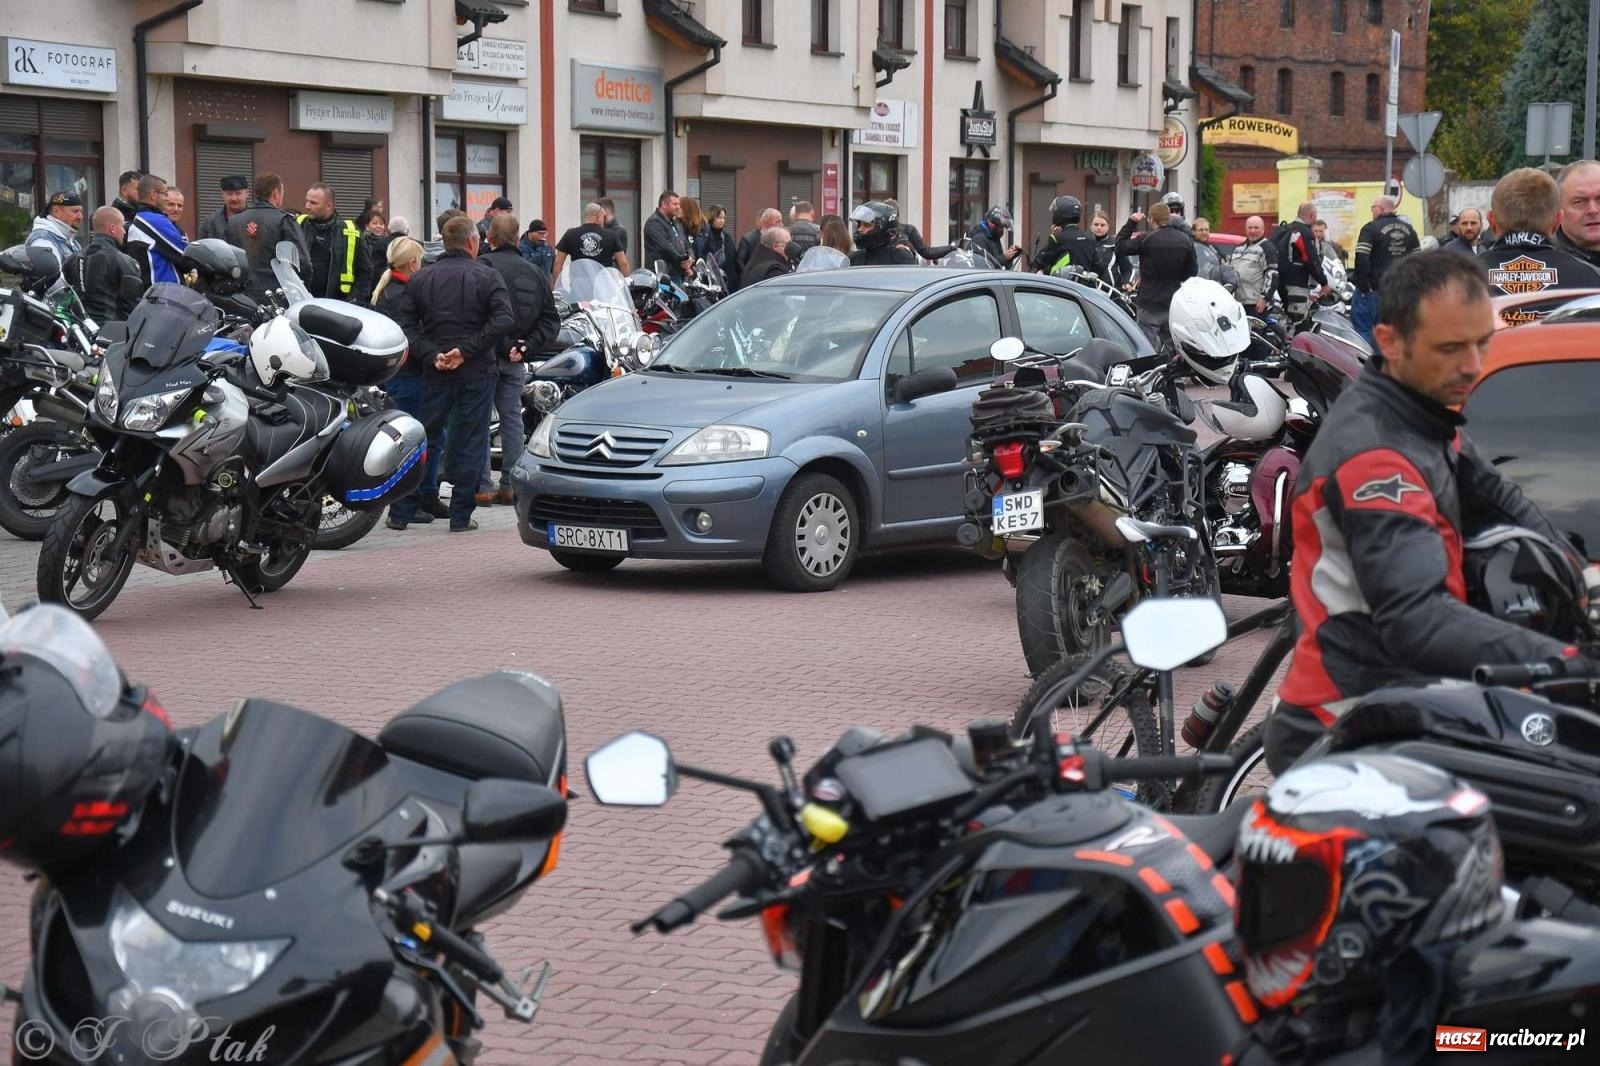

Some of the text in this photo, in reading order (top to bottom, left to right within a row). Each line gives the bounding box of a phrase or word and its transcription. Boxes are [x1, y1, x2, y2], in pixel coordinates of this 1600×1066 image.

[47, 51, 112, 70] FOTOGRAF
[594, 70, 652, 103] dentica
[305, 103, 331, 120] Fryzjer
[332, 105, 360, 120] Damsko
[1228, 119, 1293, 138] ROWERÓW
[1158, 133, 1184, 149] SKIE
[1505, 231, 1545, 246] HARLEY
[1508, 261, 1539, 271] MOTOR
[1493, 271, 1552, 282] HARLEY-DAVIDSON
[1508, 282, 1538, 294] CYCLES
[1005, 495, 1033, 512] SWD
[997, 511, 1039, 531] KE57
[557, 527, 623, 549] SRC 8XT1
[165, 900, 235, 930] SUZUKI
